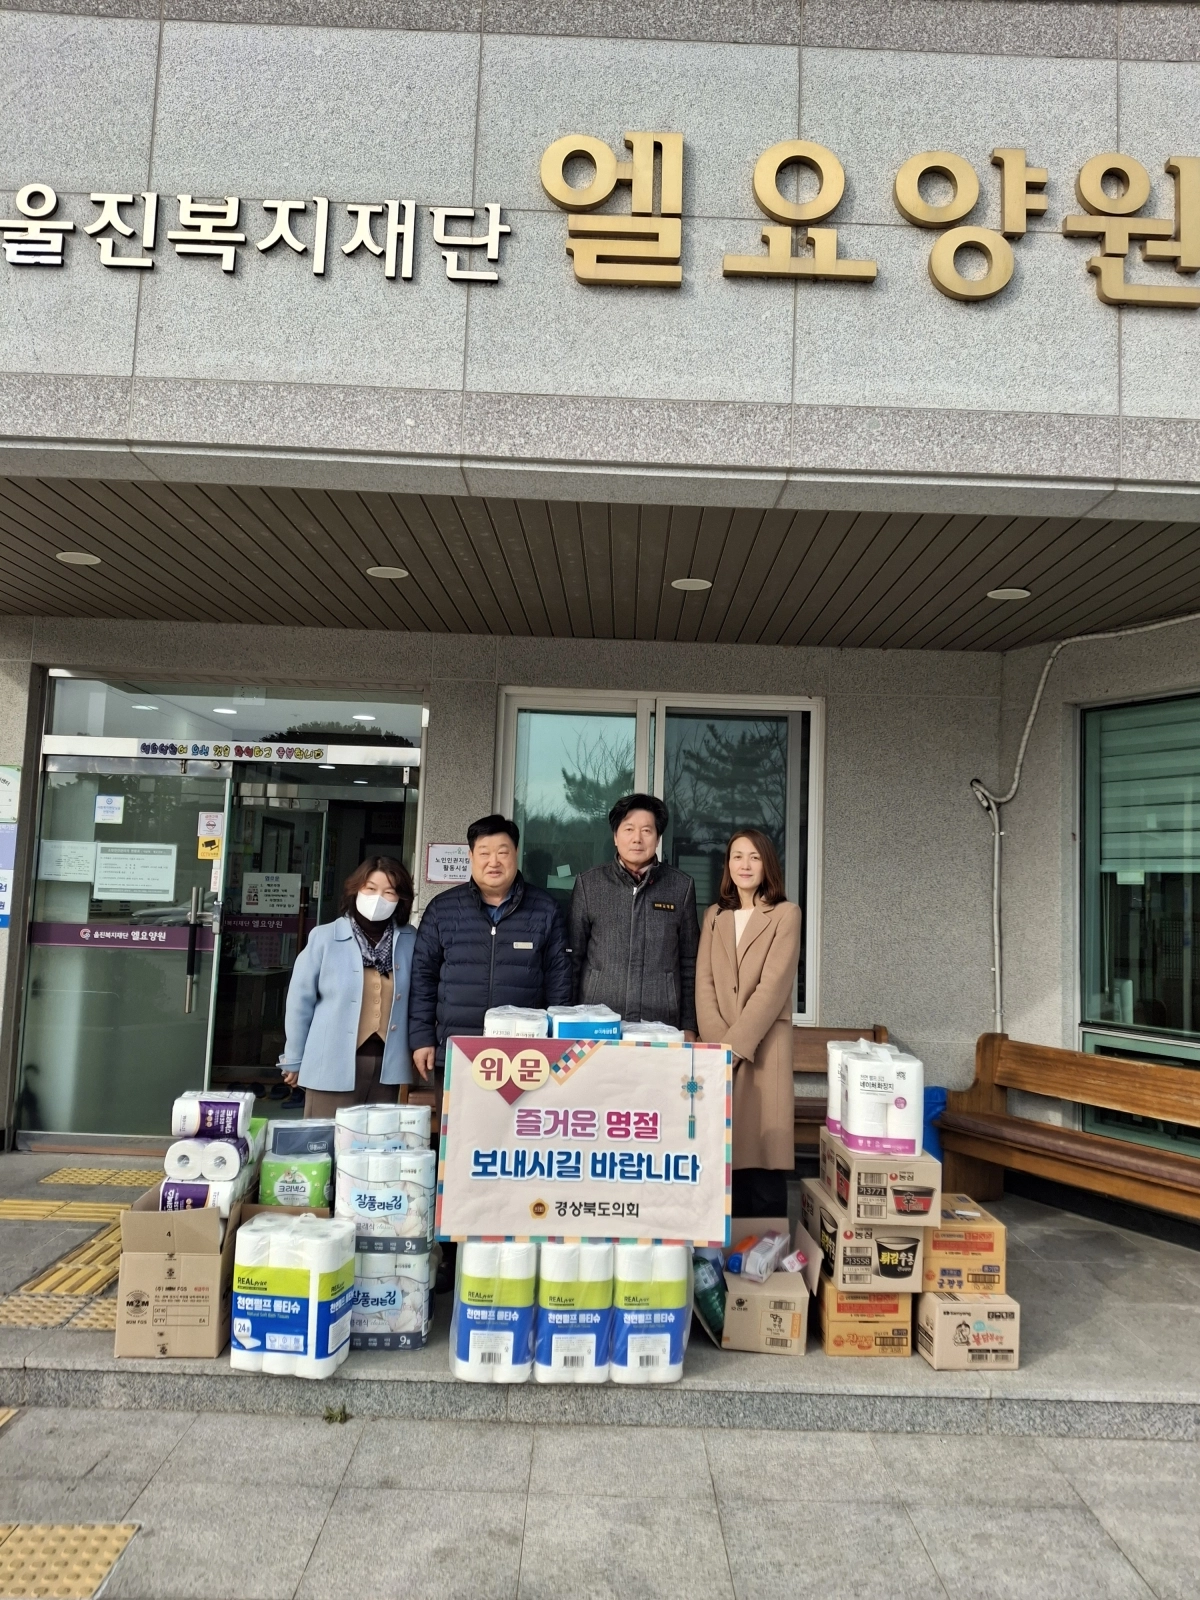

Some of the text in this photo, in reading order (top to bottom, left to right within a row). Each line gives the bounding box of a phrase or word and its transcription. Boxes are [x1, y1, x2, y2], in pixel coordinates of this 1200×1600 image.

[0, 131, 1200, 309] 울진복지재단 엘요양원
[443, 864, 468, 872] 활동시설
[251, 920, 283, 929] 엘요양원
[93, 930, 167, 942] 울진복지재단 엘요양원
[515, 1108, 659, 1140] 즐거운 명절
[471, 1149, 701, 1183] 보내시길 바랍니다
[278, 1185, 306, 1193] 크리넥스
[860, 1187, 885, 1195] 가3771
[355, 1194, 403, 1211] 잘풀리는집
[554, 1201, 640, 1218] 경상북도의회
[355, 1222, 375, 1231] 클래식
[855, 1231, 872, 1239] 농심
[845, 1257, 870, 1265] 가3558
[880, 1251, 914, 1267] 튀김우동
[126, 1299, 149, 1308] M2M
[237, 1296, 300, 1314] 천연펄프 롤티슈
[466, 1308, 495, 1320] 천연펄프
[548, 1312, 577, 1324] 천연펄프
[623, 1312, 652, 1324] 천연펄프
